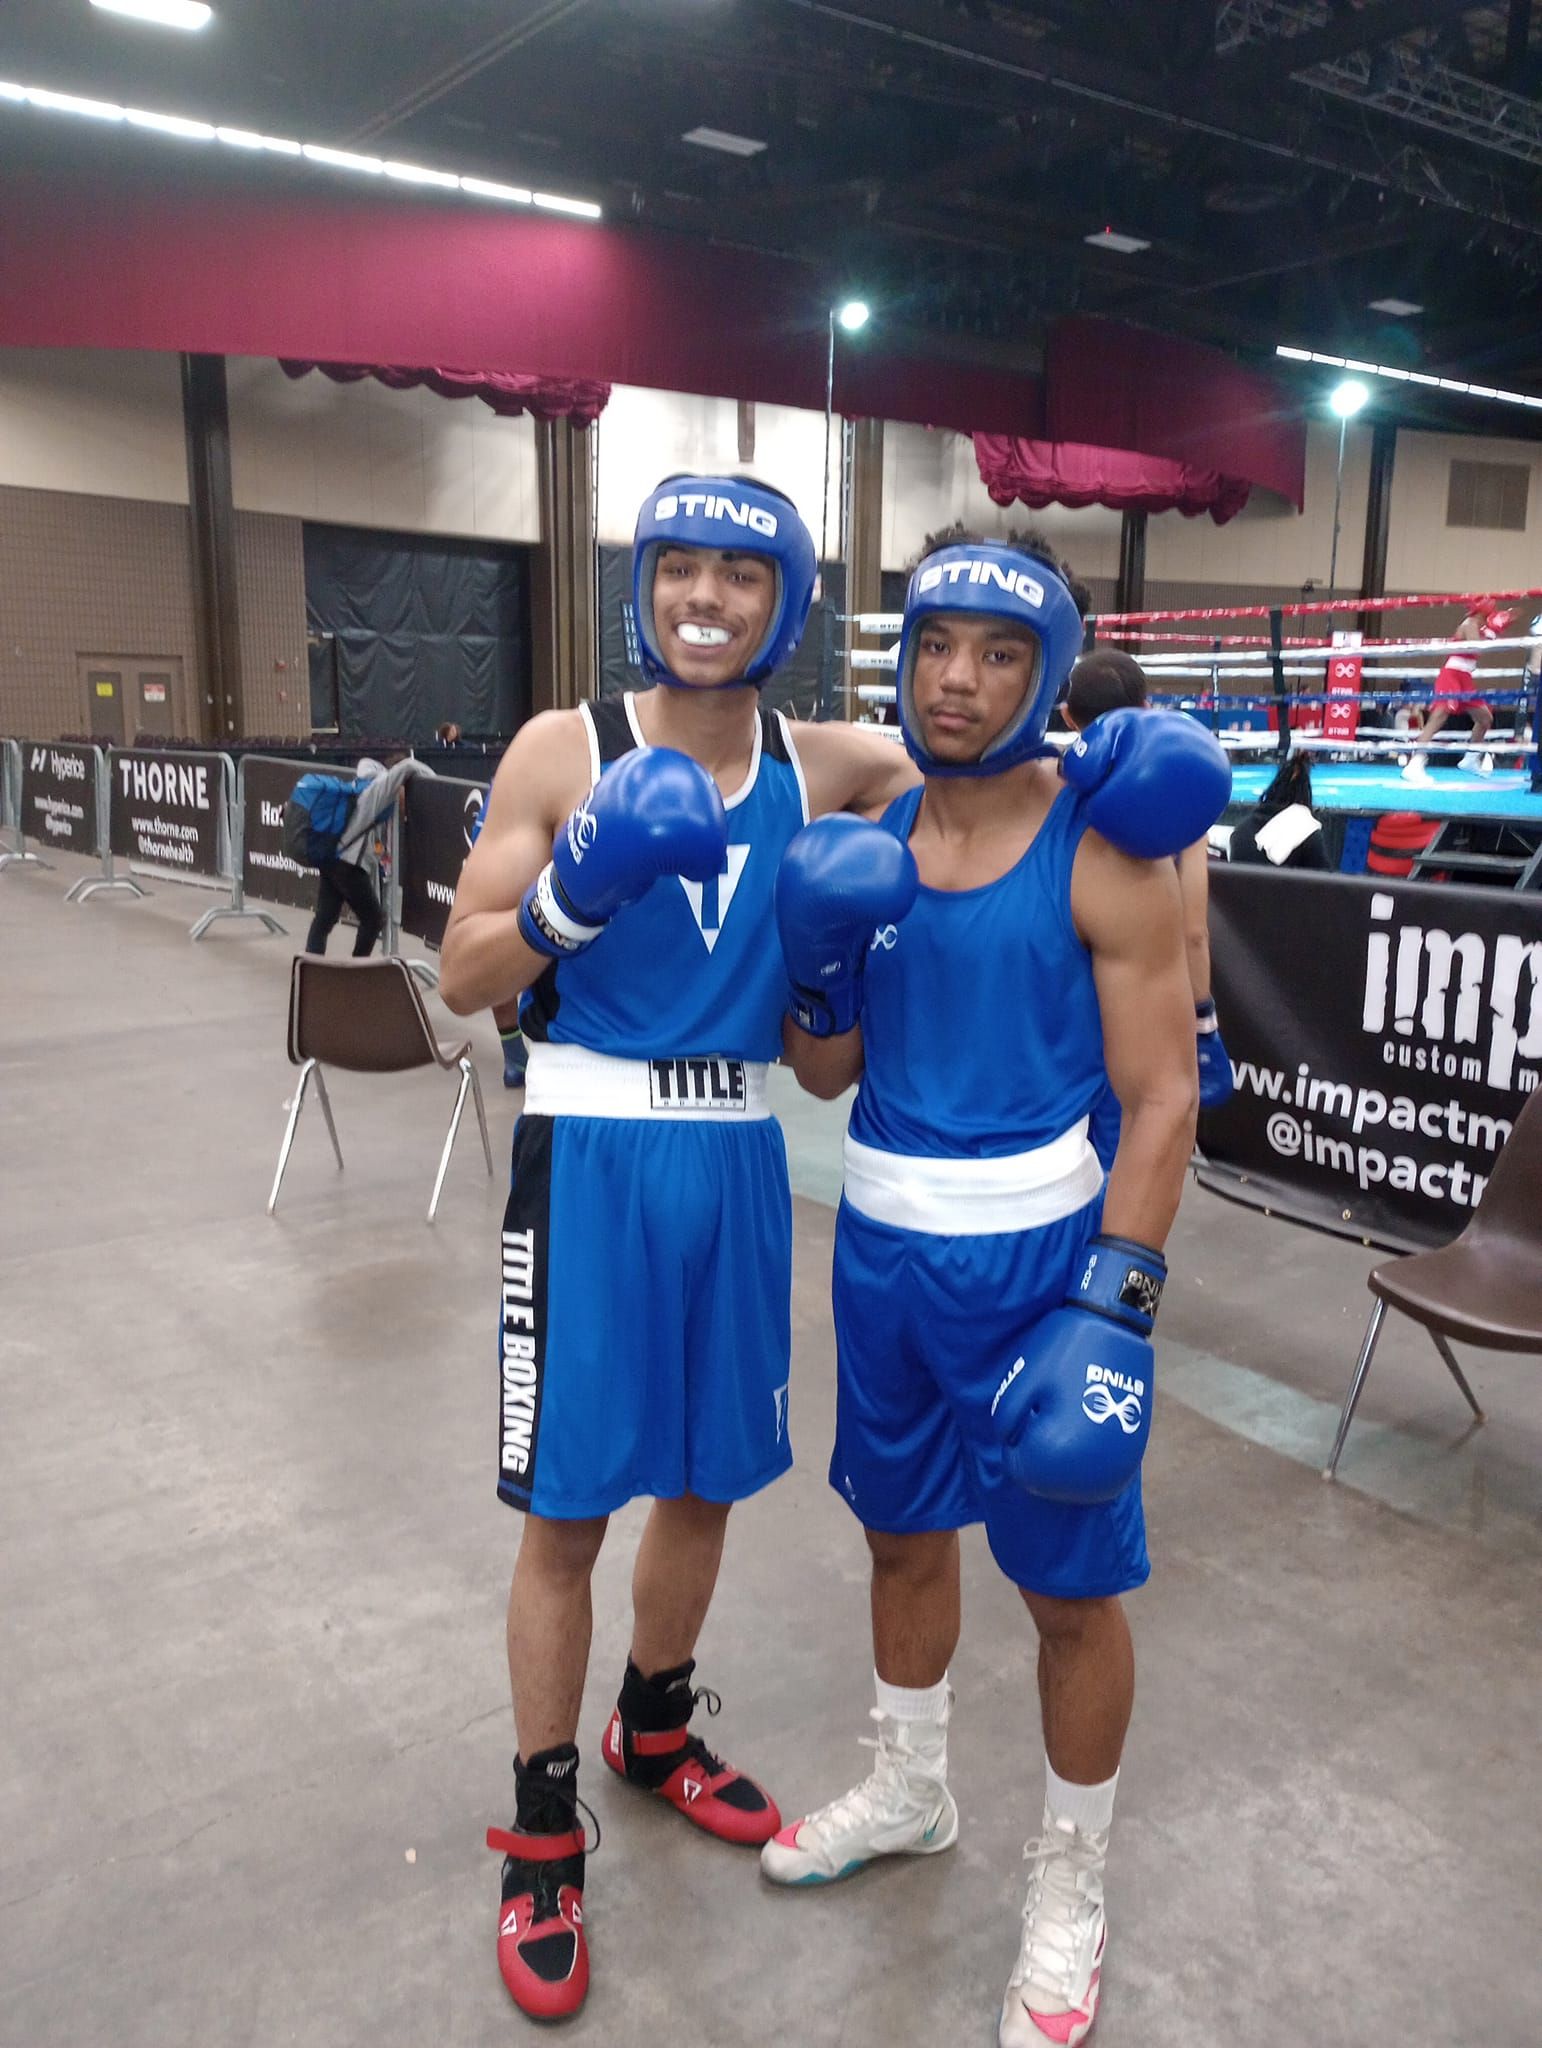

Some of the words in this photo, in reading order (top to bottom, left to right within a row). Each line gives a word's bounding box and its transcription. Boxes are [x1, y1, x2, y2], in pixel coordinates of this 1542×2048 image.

[654, 494, 778, 538] STING
[918, 560, 1045, 609] STING
[119, 759, 209, 810] THORNE
[131, 816, 199, 843] www.thorne.com
[138, 834, 195, 864] @thornehealth
[652, 1060, 744, 1100] TITLE
[1382, 1041, 1482, 1083] custom
[502, 1228, 534, 1330] TITLE
[502, 1330, 538, 1475] BOXING
